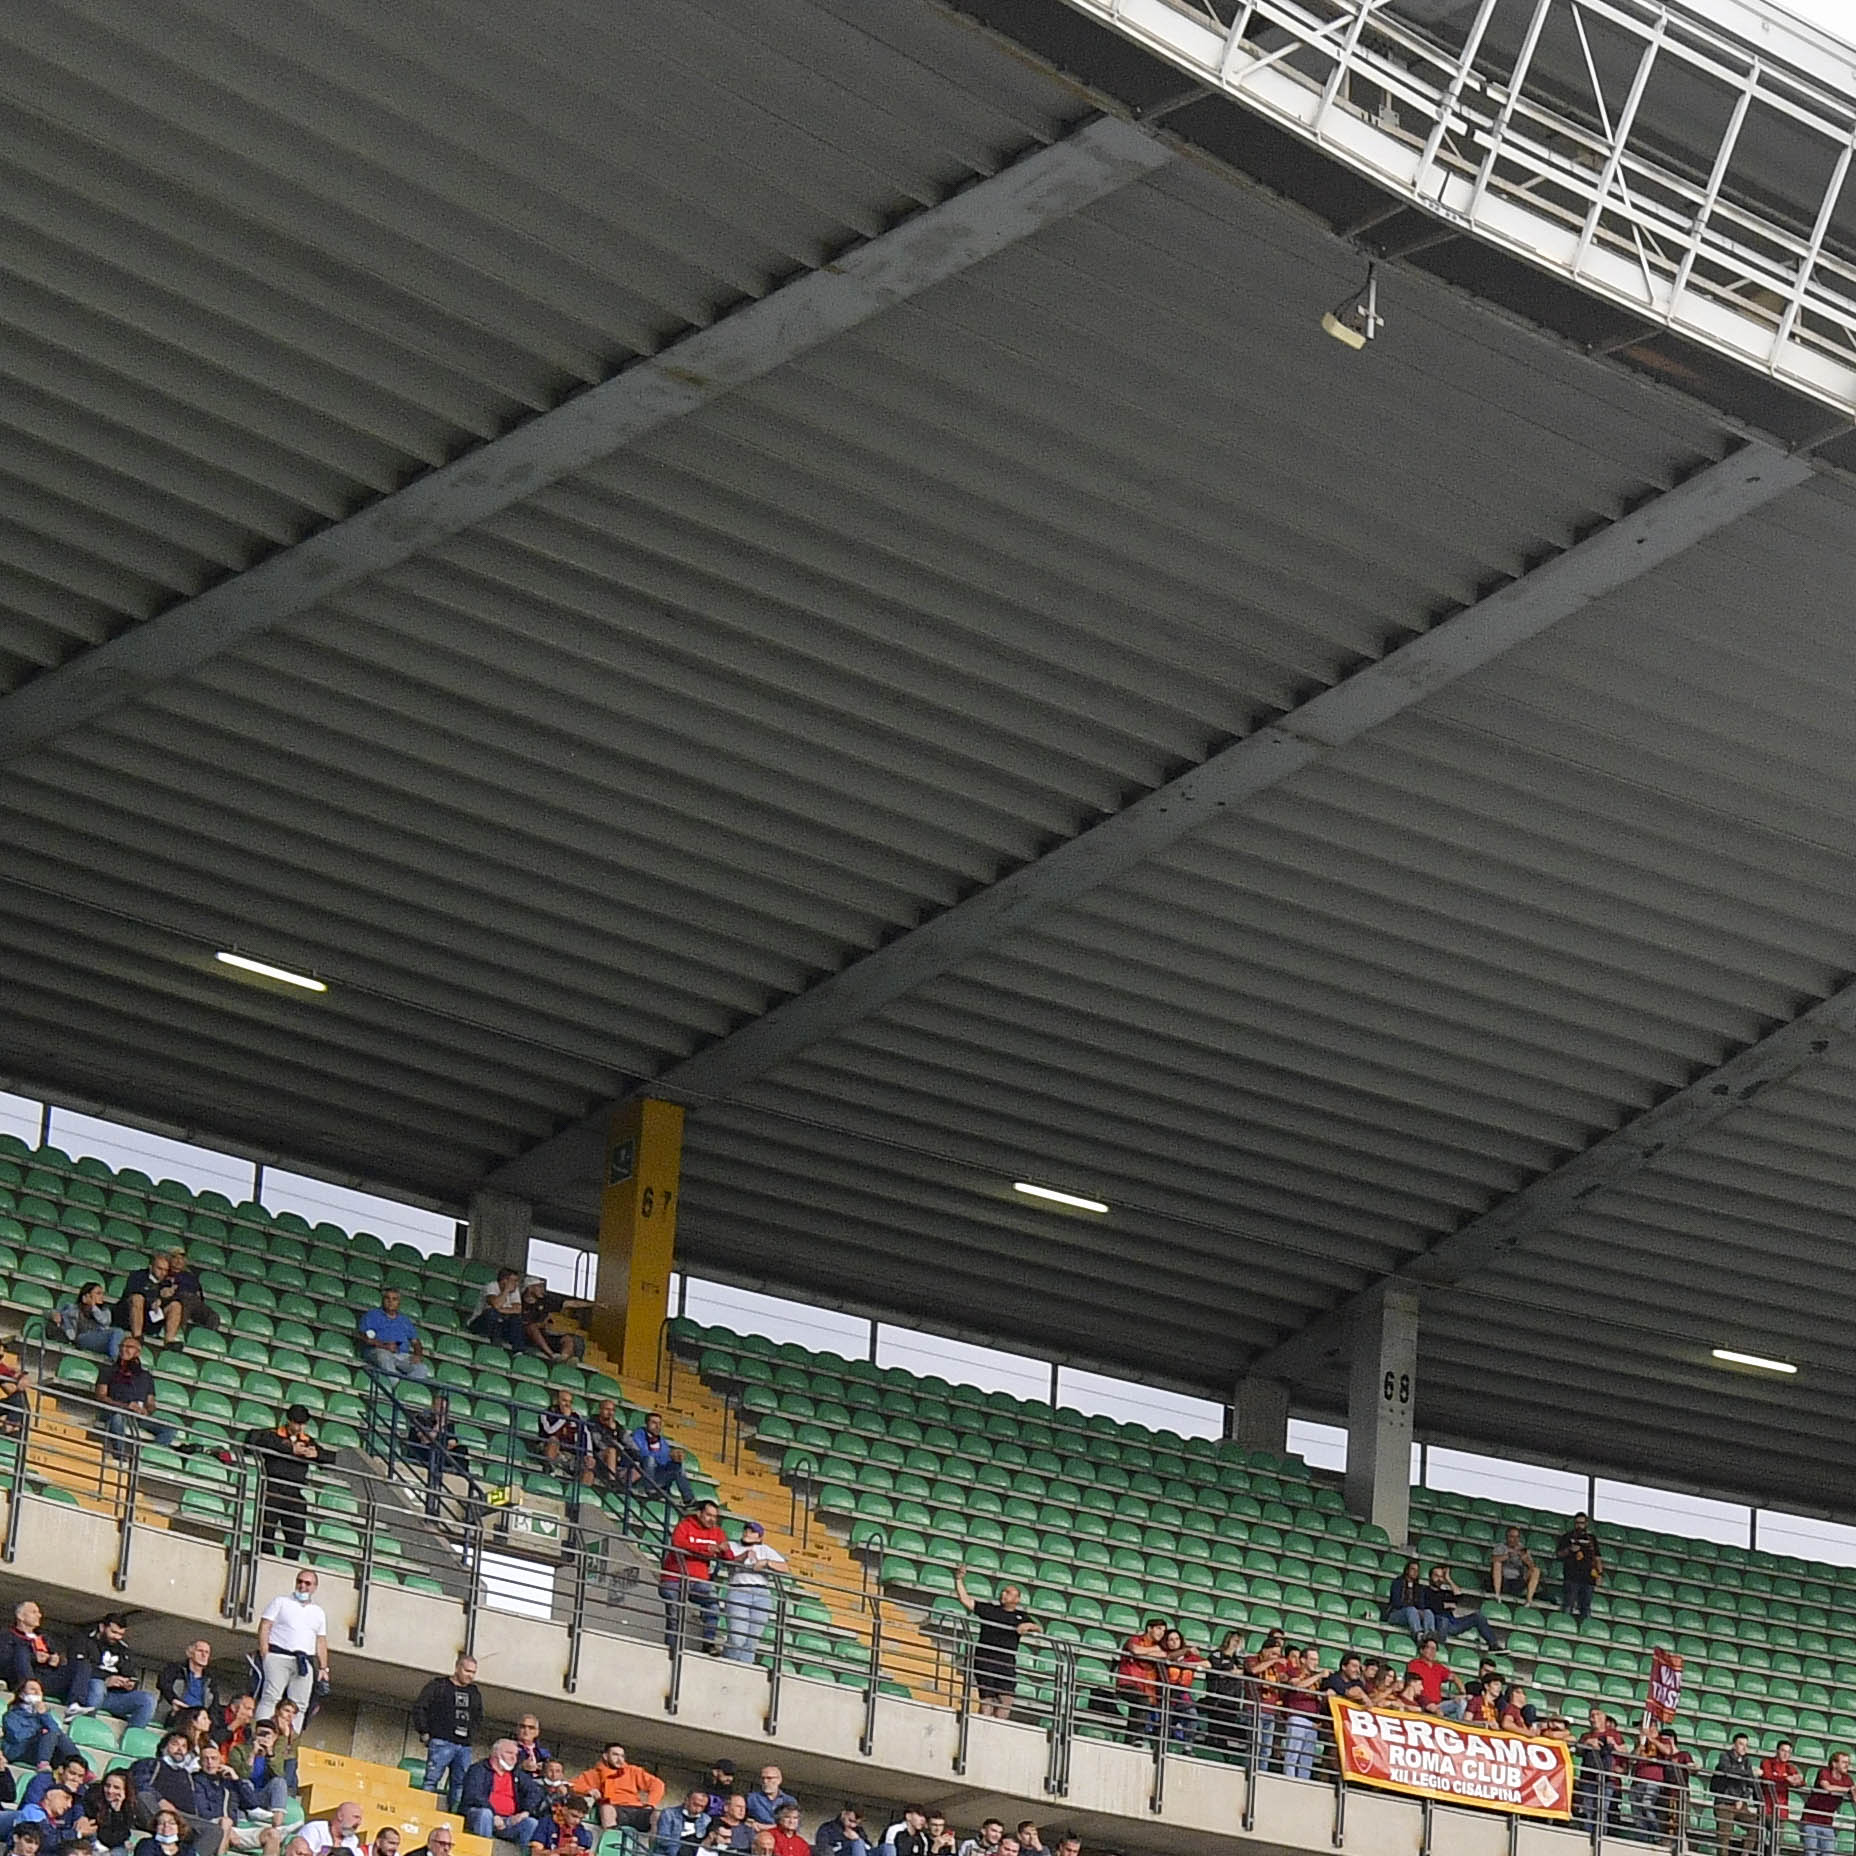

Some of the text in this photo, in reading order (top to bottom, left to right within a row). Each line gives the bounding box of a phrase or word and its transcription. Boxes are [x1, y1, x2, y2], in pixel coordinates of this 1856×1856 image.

[1384, 1371, 1409, 1403] 68
[1347, 1708, 1558, 1770] BERGAMO
[1389, 1746, 1522, 1788] ROMA CLUB
[1390, 1768, 1522, 1803] XII LEGIO CISALPINA
